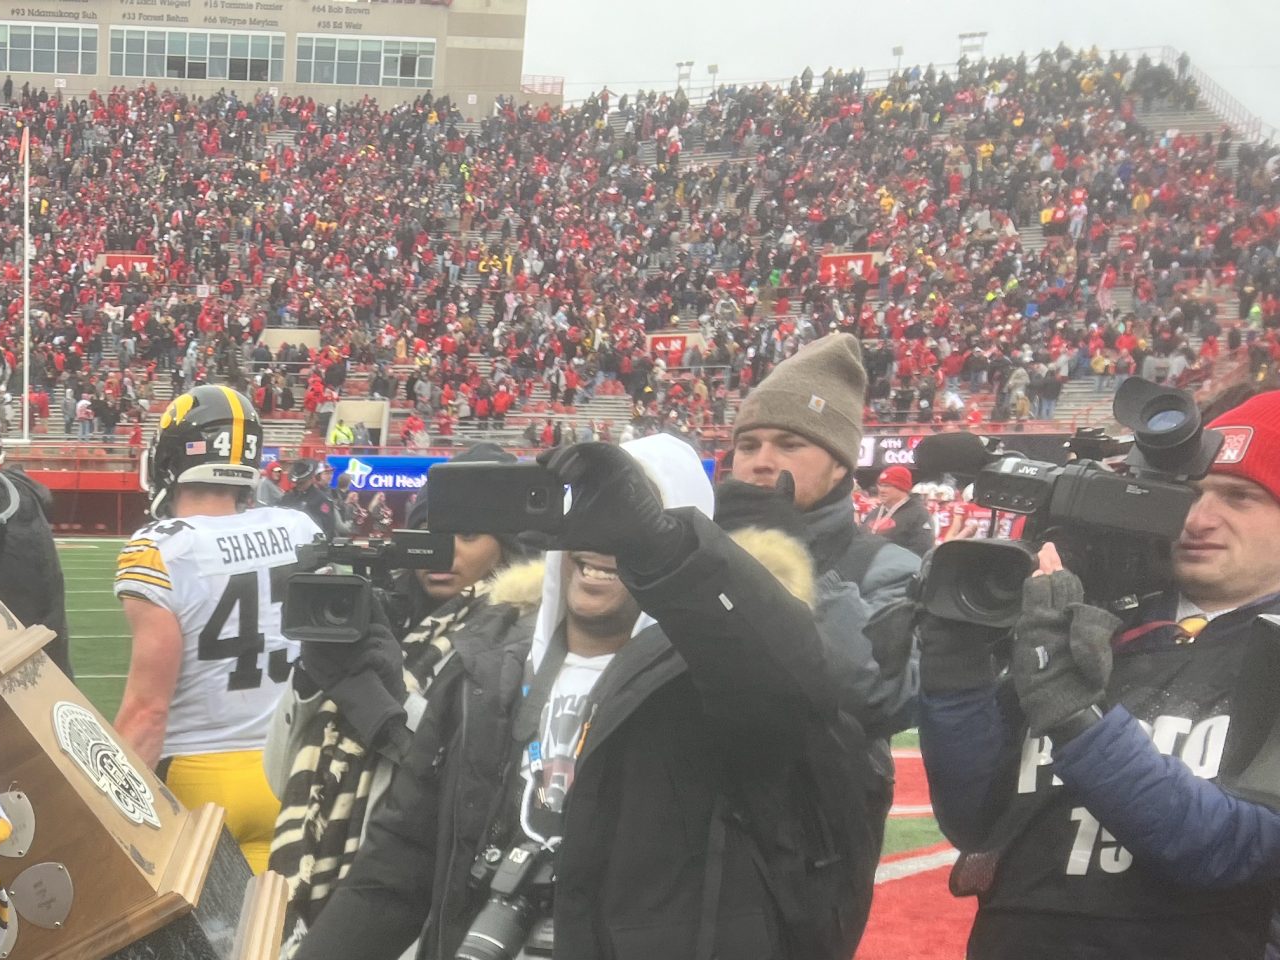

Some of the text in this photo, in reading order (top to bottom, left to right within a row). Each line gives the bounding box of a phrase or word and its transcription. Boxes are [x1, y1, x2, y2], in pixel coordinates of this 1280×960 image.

[220, 1, 253, 9] Tommie
[255, 2, 283, 11] Frazier
[328, 5, 343, 13] Bob
[345, 6, 370, 15] Brown
[11, 8, 97, 20] #93 Ndamukong Suh
[220, 16, 247, 26] Wayne
[333, 21, 343, 29] Ed
[345, 22, 362, 30] Weir
[880, 438, 902, 449] 4TH
[1018, 466, 1039, 476] JVC
[369, 473, 428, 488] CHI Heal
[216, 526, 294, 565] SHARAR
